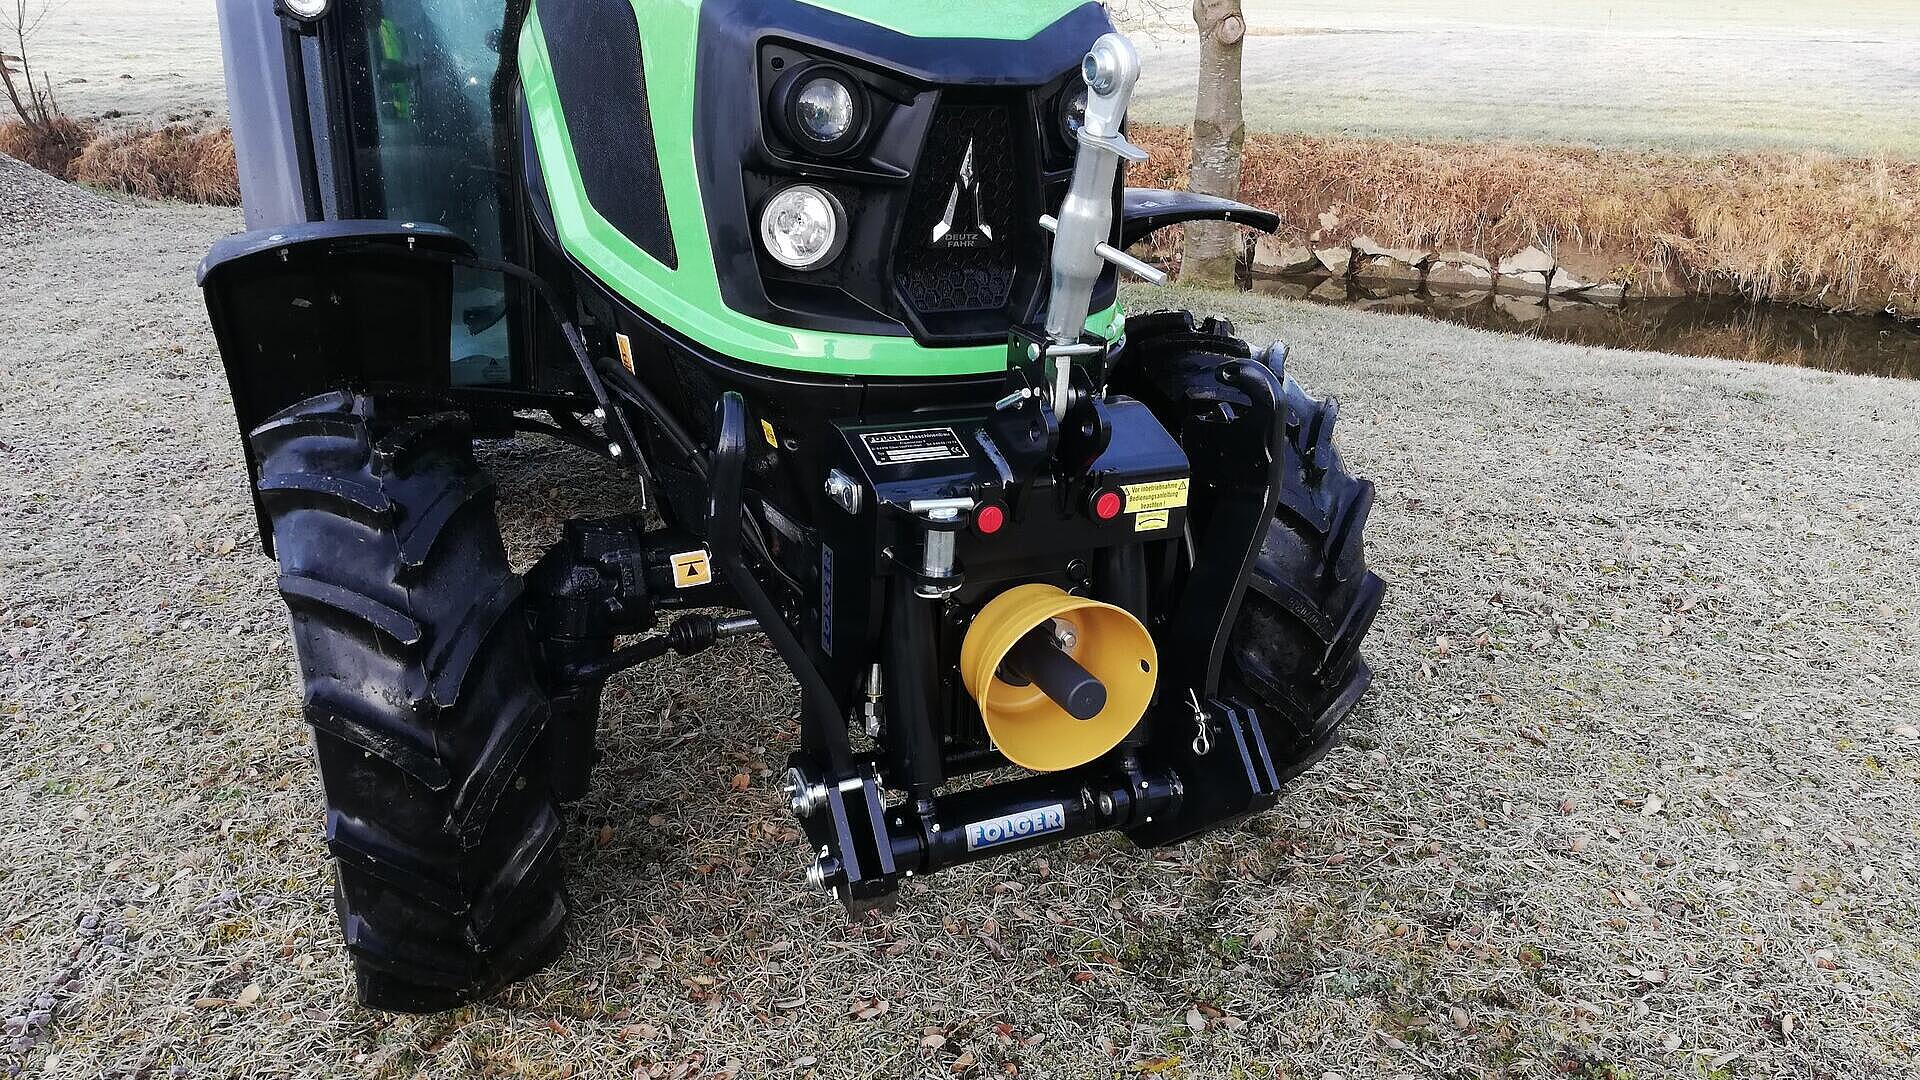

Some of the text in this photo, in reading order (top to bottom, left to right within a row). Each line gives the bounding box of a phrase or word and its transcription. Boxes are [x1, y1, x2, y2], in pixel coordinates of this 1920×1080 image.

[945, 233, 979, 241] DEUTZ
[947, 240, 975, 248] FAHR
[1131, 485, 1141, 493] Vor
[1129, 491, 1179, 502] Bedienungsanleitung
[969, 809, 1061, 847] FOLGER
